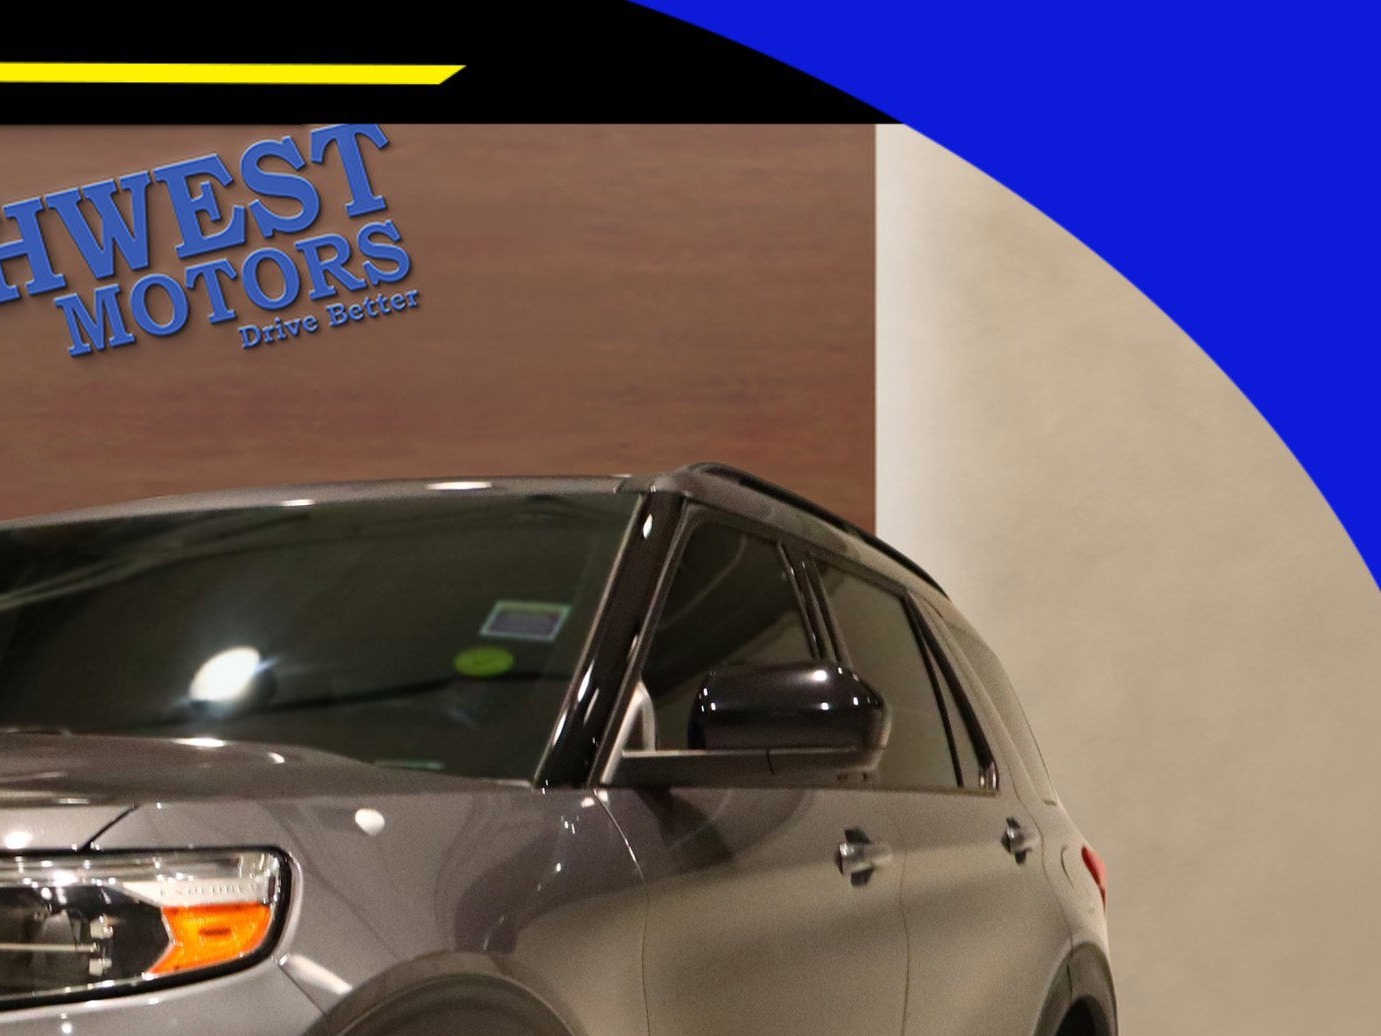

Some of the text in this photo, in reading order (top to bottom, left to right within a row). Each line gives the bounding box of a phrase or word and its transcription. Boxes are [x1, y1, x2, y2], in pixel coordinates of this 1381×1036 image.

[54, 220, 411, 356] MOTORS
[239, 290, 420, 349] Drive Better
